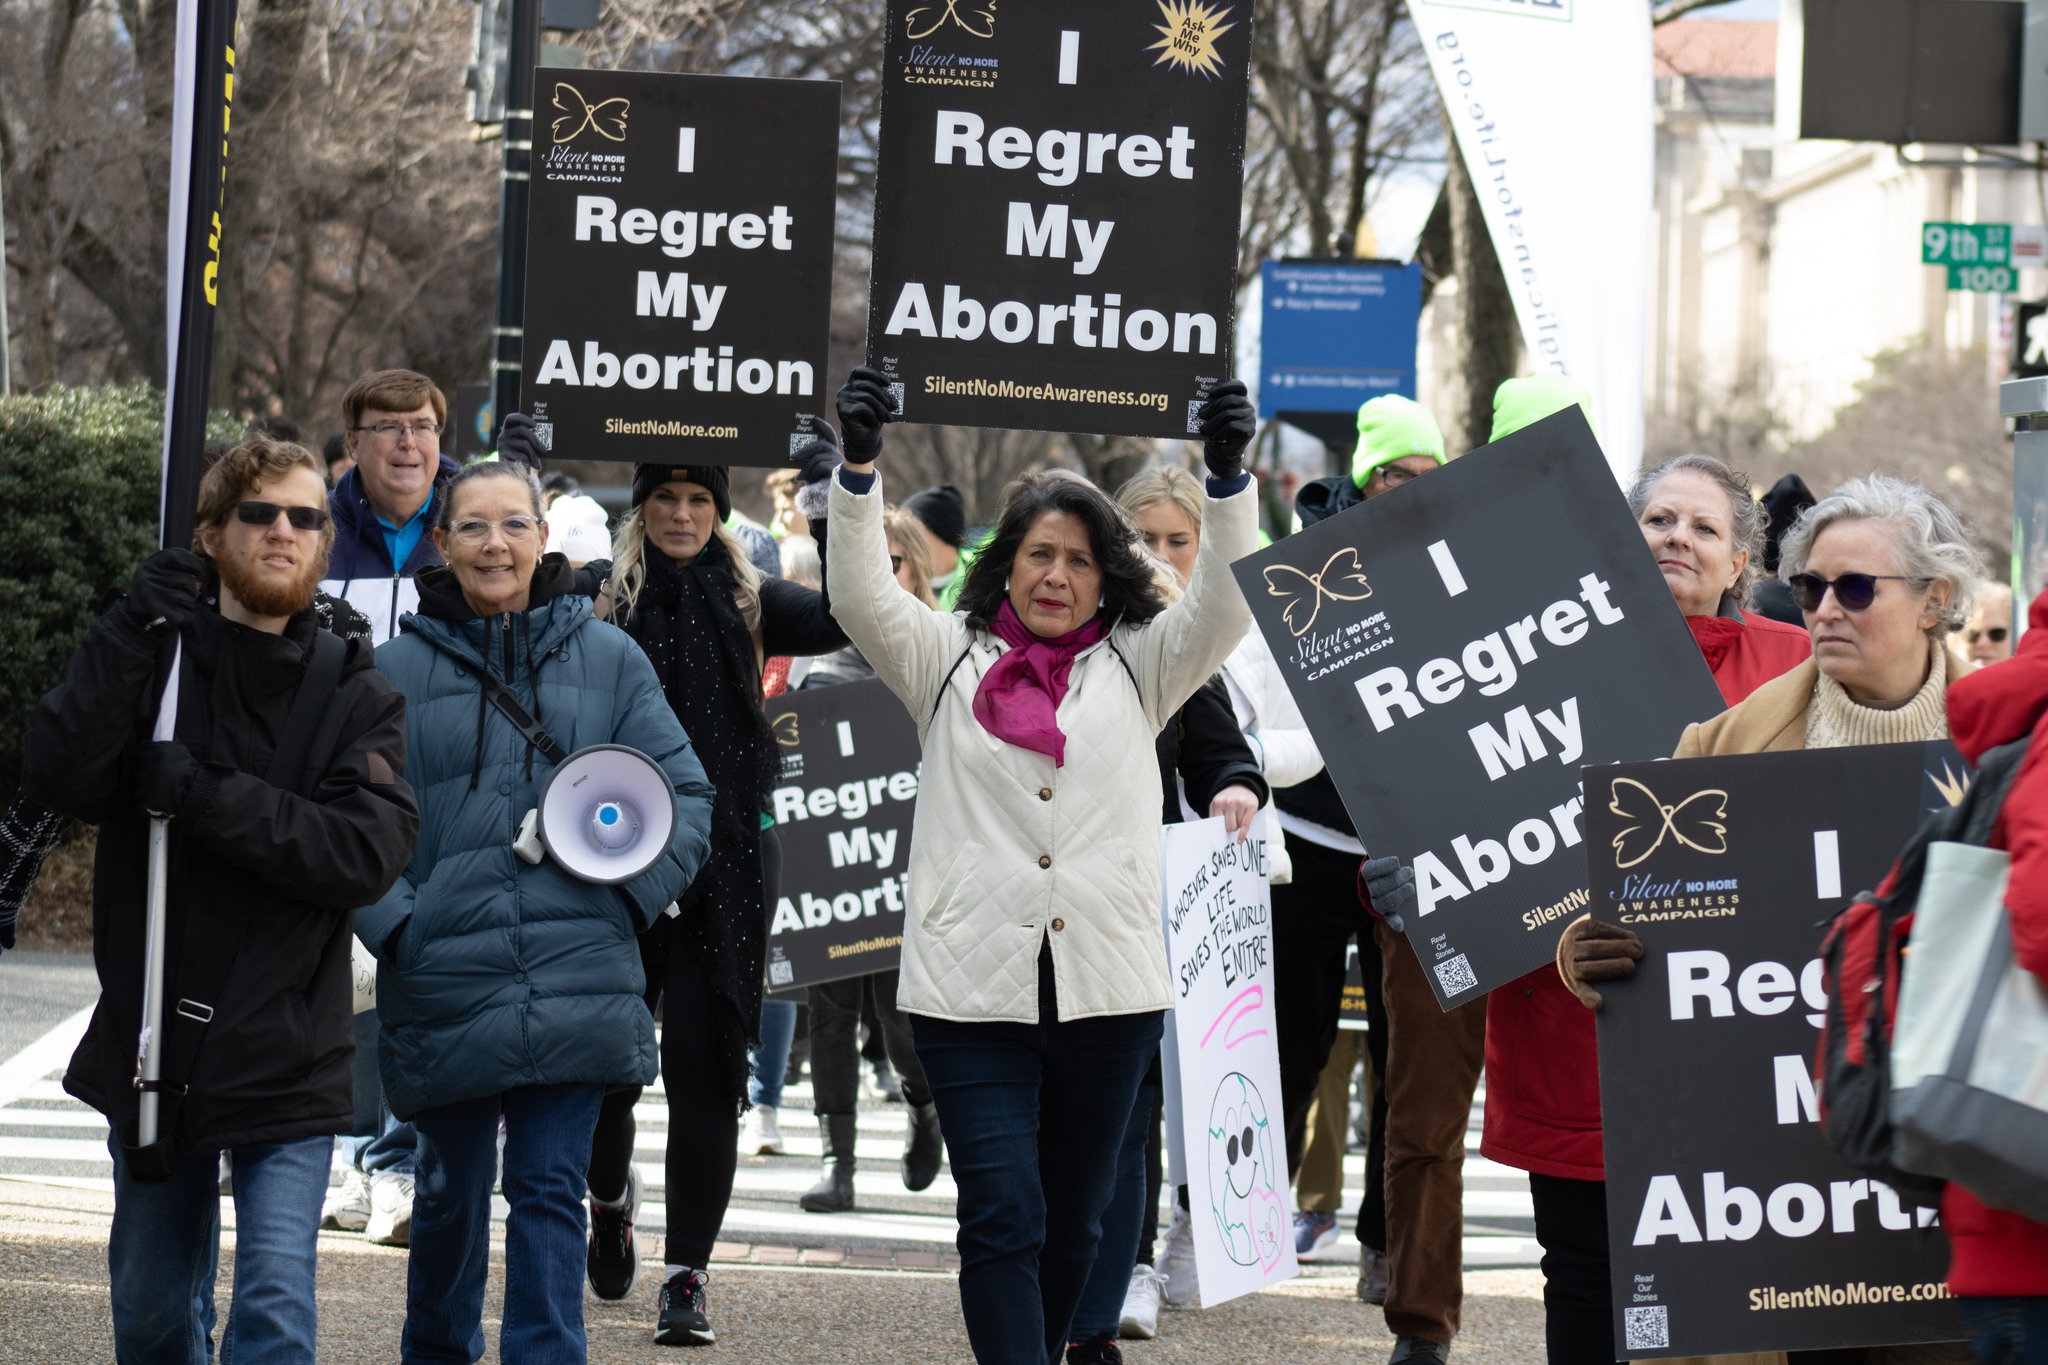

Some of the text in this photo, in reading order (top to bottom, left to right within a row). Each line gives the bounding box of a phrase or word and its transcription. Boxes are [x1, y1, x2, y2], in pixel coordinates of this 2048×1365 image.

[1180, 28, 1200, 44] Me
[1182, 17, 1206, 33] Ask
[898, 44, 998, 68] Silent NO MORE
[1059, 30, 1080, 84] I
[1174, 37, 1200, 57] Why
[904, 66, 998, 79] AWARENESS
[904, 76, 994, 88] CAMPAIGN
[542, 144, 590, 163] Silent
[604, 155, 626, 164] MORE
[546, 162, 626, 172] AWARENESS
[678, 127, 696, 172] I
[934, 110, 1196, 187] Regret
[546, 174, 622, 183] CAMPAIGN
[575, 195, 793, 258] Regret
[1006, 201, 1116, 276] My
[1924, 225, 1979, 260] 9th
[1957, 266, 2010, 290] 100
[636, 270, 728, 331] My
[884, 282, 1217, 354] Abortion
[535, 339, 814, 396] Abortion
[924, 376, 1168, 412] SilentNoMoreAwareness.org
[605, 418, 738, 438] SilentNoMore.com
[1427, 539, 1468, 598] I
[1290, 612, 1386, 664] Silent NO MORE
[1300, 622, 1391, 670] AWARENESS
[1354, 572, 1625, 733] Regret
[1308, 636, 1394, 680] CAMPAIGN
[836, 720, 854, 757] I
[1467, 696, 1583, 781] My
[772, 761, 922, 825] Regre
[828, 826, 898, 868] My
[1412, 781, 1584, 918] Abor
[1814, 830, 1842, 900] I
[1169, 838, 1266, 935] WHOEVER SAVES ONE
[1206, 880, 1236, 924] LIFE
[1610, 873, 1738, 900] Silent NO MORE
[1618, 894, 1740, 912] AWARENESS
[1620, 907, 1736, 924] CAMPAIGN
[1180, 904, 1267, 998] SAVES THE WORLD
[1430, 932, 1446, 945] Read
[1436, 942, 1447, 950] Our
[1436, 946, 1456, 960] Stories
[1221, 936, 1268, 989] ENTIRE
[1634, 1274, 1654, 1282] Read
[1638, 1284, 1652, 1292] Our
[1633, 1293, 1658, 1302] Stories
